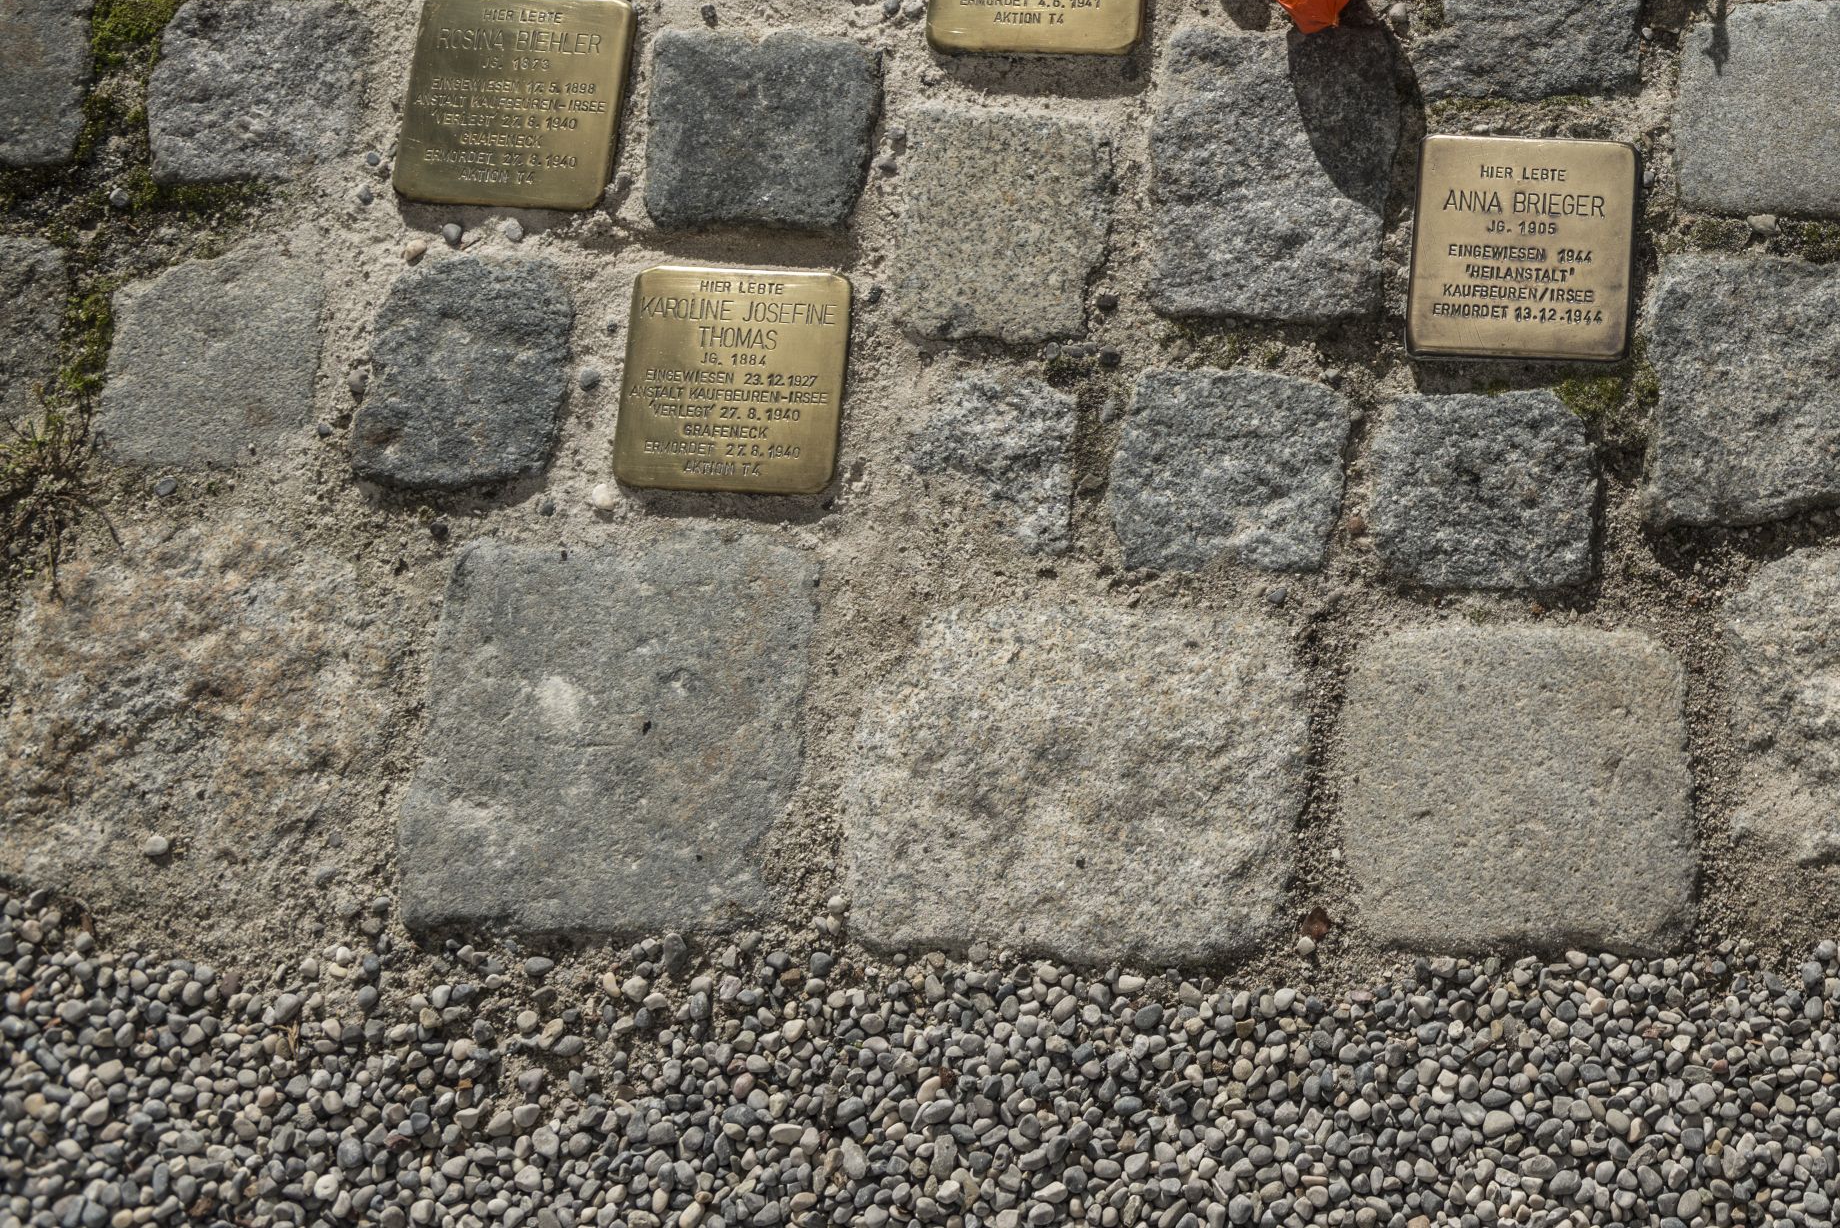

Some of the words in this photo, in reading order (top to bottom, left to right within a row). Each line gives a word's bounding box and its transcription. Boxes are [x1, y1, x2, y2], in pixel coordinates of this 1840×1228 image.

[483, 9, 513, 22] HIER
[519, 10, 564, 23] LEBTE
[994, 12, 1041, 25] AKTION
[1049, 14, 1064, 25] T4
[437, 28, 505, 51] ROSINA
[515, 30, 601, 55] BIEHLER
[431, 78, 520, 94] EINGEWIESEN
[413, 94, 468, 108] ANSTALT
[460, 132, 543, 149] GRAFENECK
[424, 149, 495, 166] ERMORDET
[458, 169, 509, 183] AKTION
[516, 172, 534, 185] T4
[1480, 165, 1513, 179] HIER
[1522, 168, 1567, 181] LEBTE
[1443, 190, 1503, 213] ANNA
[1513, 192, 1605, 218] BRIEGER
[1487, 221, 1512, 233] JG.
[1519, 221, 1557, 235] 1905
[1448, 244, 1546, 262] EINGEWIESEN
[1558, 249, 1592, 264] 1944
[700, 281, 731, 293] HIER
[739, 282, 784, 295] LEBTE
[1443, 284, 1594, 303] KAUFBEUREN/IRSEE
[640, 297, 734, 321] KAROLINE
[742, 301, 837, 326] JOSEFINE
[1433, 303, 1508, 319] ERMORDET
[699, 326, 778, 350] THOMAS
[700, 353, 722, 365] JG.
[731, 353, 766, 366] 1884
[645, 370, 734, 384] EINGEWIESEN
[629, 386, 684, 399] ANSTALT
[689, 388, 828, 405] KAUFBEUREN-IRSEE
[684, 424, 769, 440] GRAFENECK
[644, 441, 715, 456] ERMORDET
[683, 461, 735, 476] AKTION
[743, 462, 761, 477] T4
